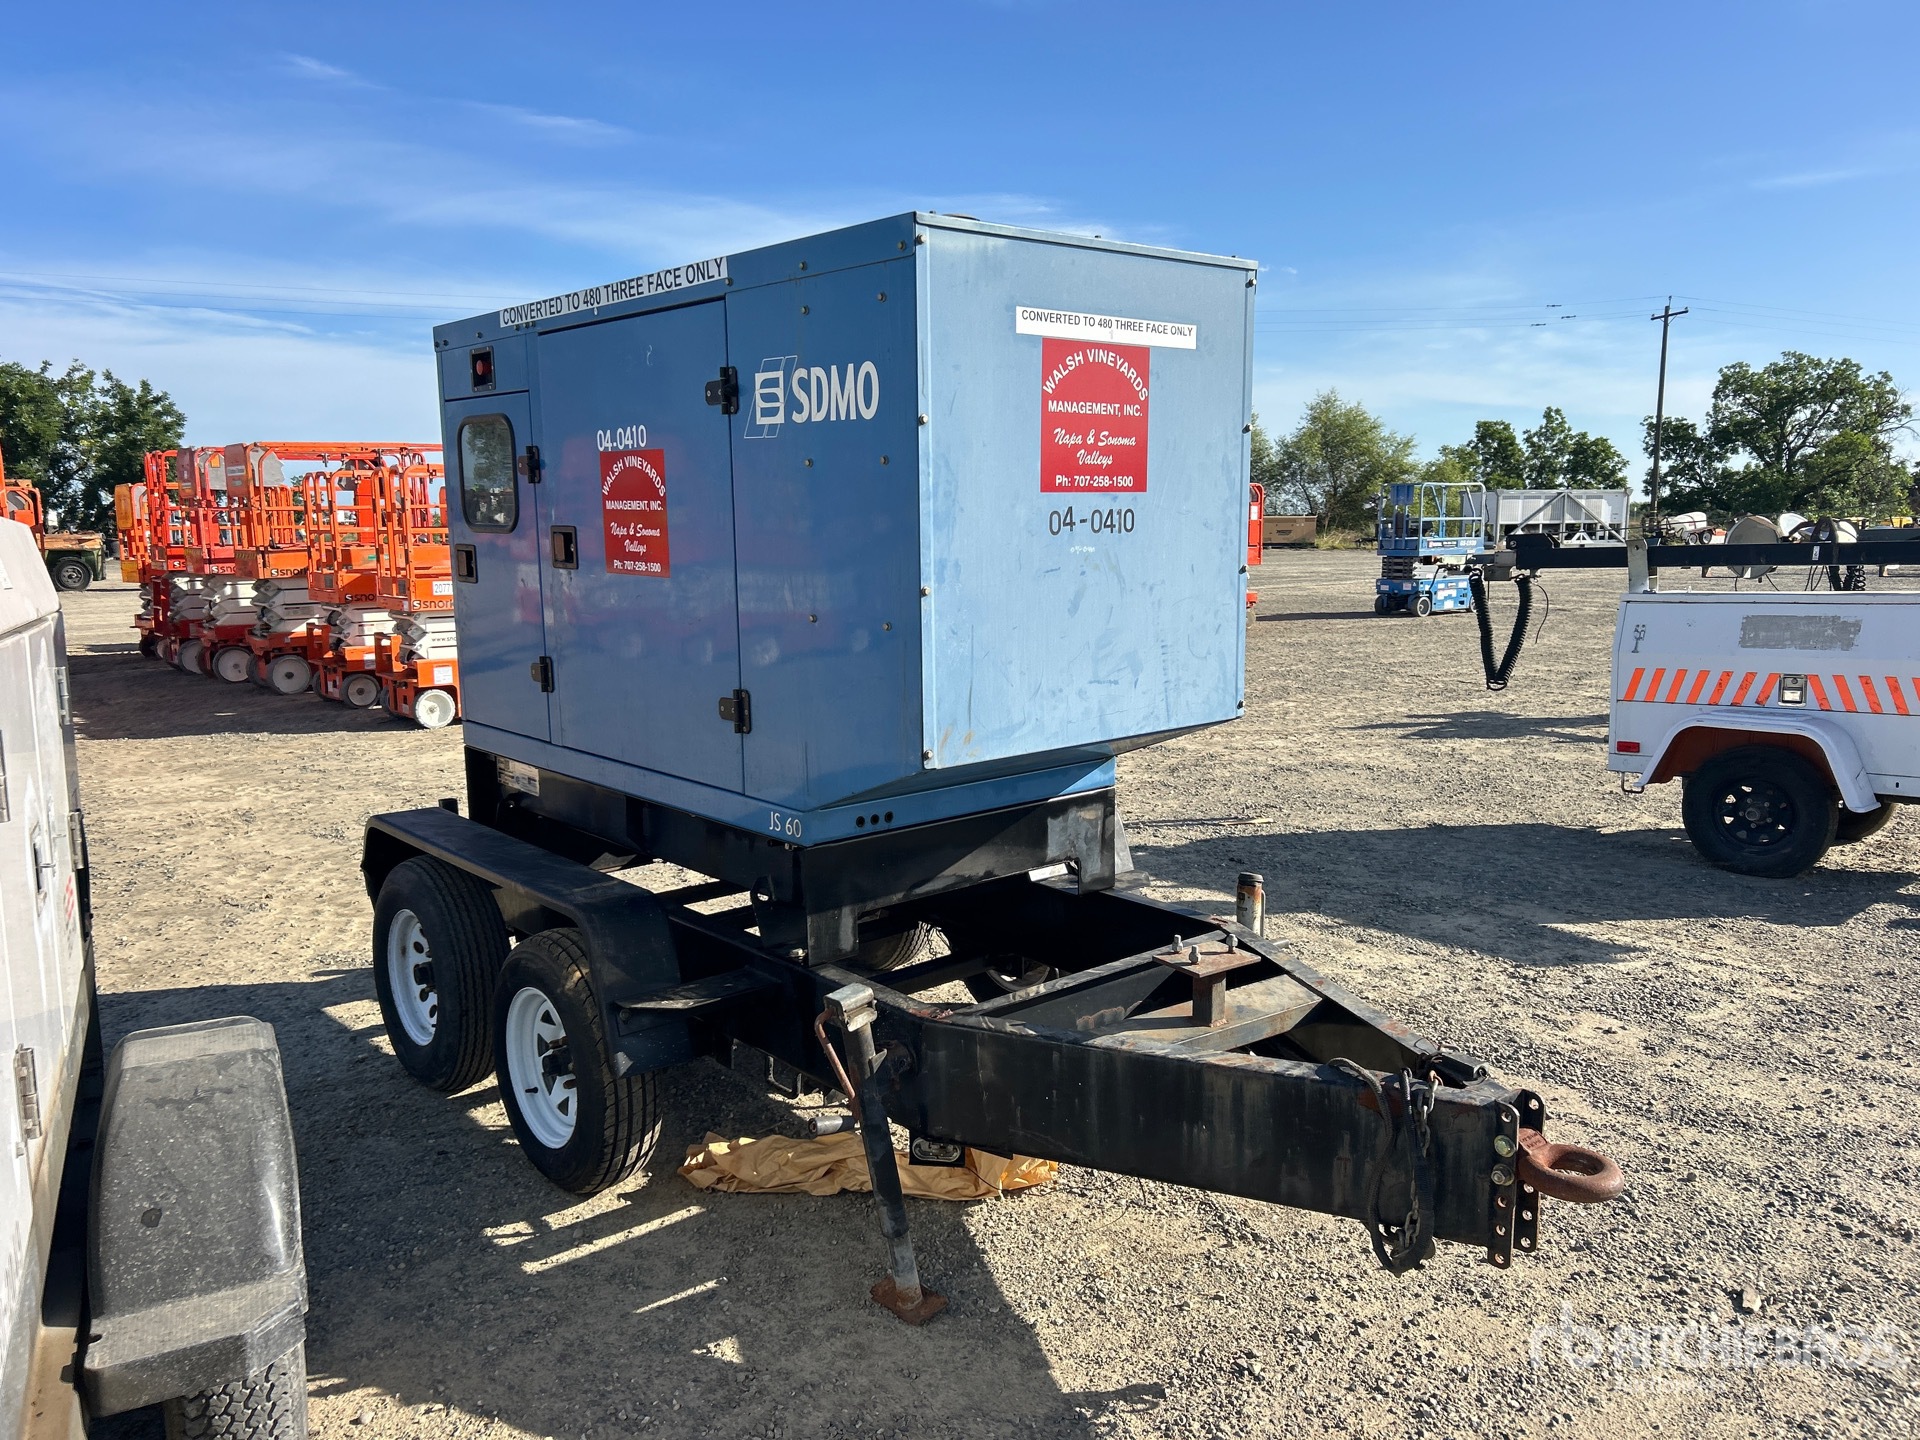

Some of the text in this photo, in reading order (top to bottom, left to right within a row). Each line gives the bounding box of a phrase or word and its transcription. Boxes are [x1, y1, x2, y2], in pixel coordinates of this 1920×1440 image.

[502, 257, 724, 325] CONVERTED TO 480 THREE FACE ONLY
[1021, 309, 1193, 337] CONVERTED TO 480 THREE FACE ONLY
[1042, 349, 1149, 401] WALSH VINEYARDS
[791, 360, 880, 424] SDMO
[1048, 400, 1143, 417] MANAGEMENT, INC.
[1053, 427, 1137, 448] Napa & Sonoma
[1076, 448, 1113, 469] Valleys
[602, 455, 666, 497] WALSH VINEYARDS
[1055, 475, 1134, 487] Ph: 707-258-1500
[605, 500, 664, 512] MANAGEMENT, INC.
[610, 521, 661, 538] Napa & Sonoma
[623, 539, 647, 556] Valleys
[613, 559, 662, 573] Ph: 707-258-1500
[768, 811, 802, 838] JS 60
